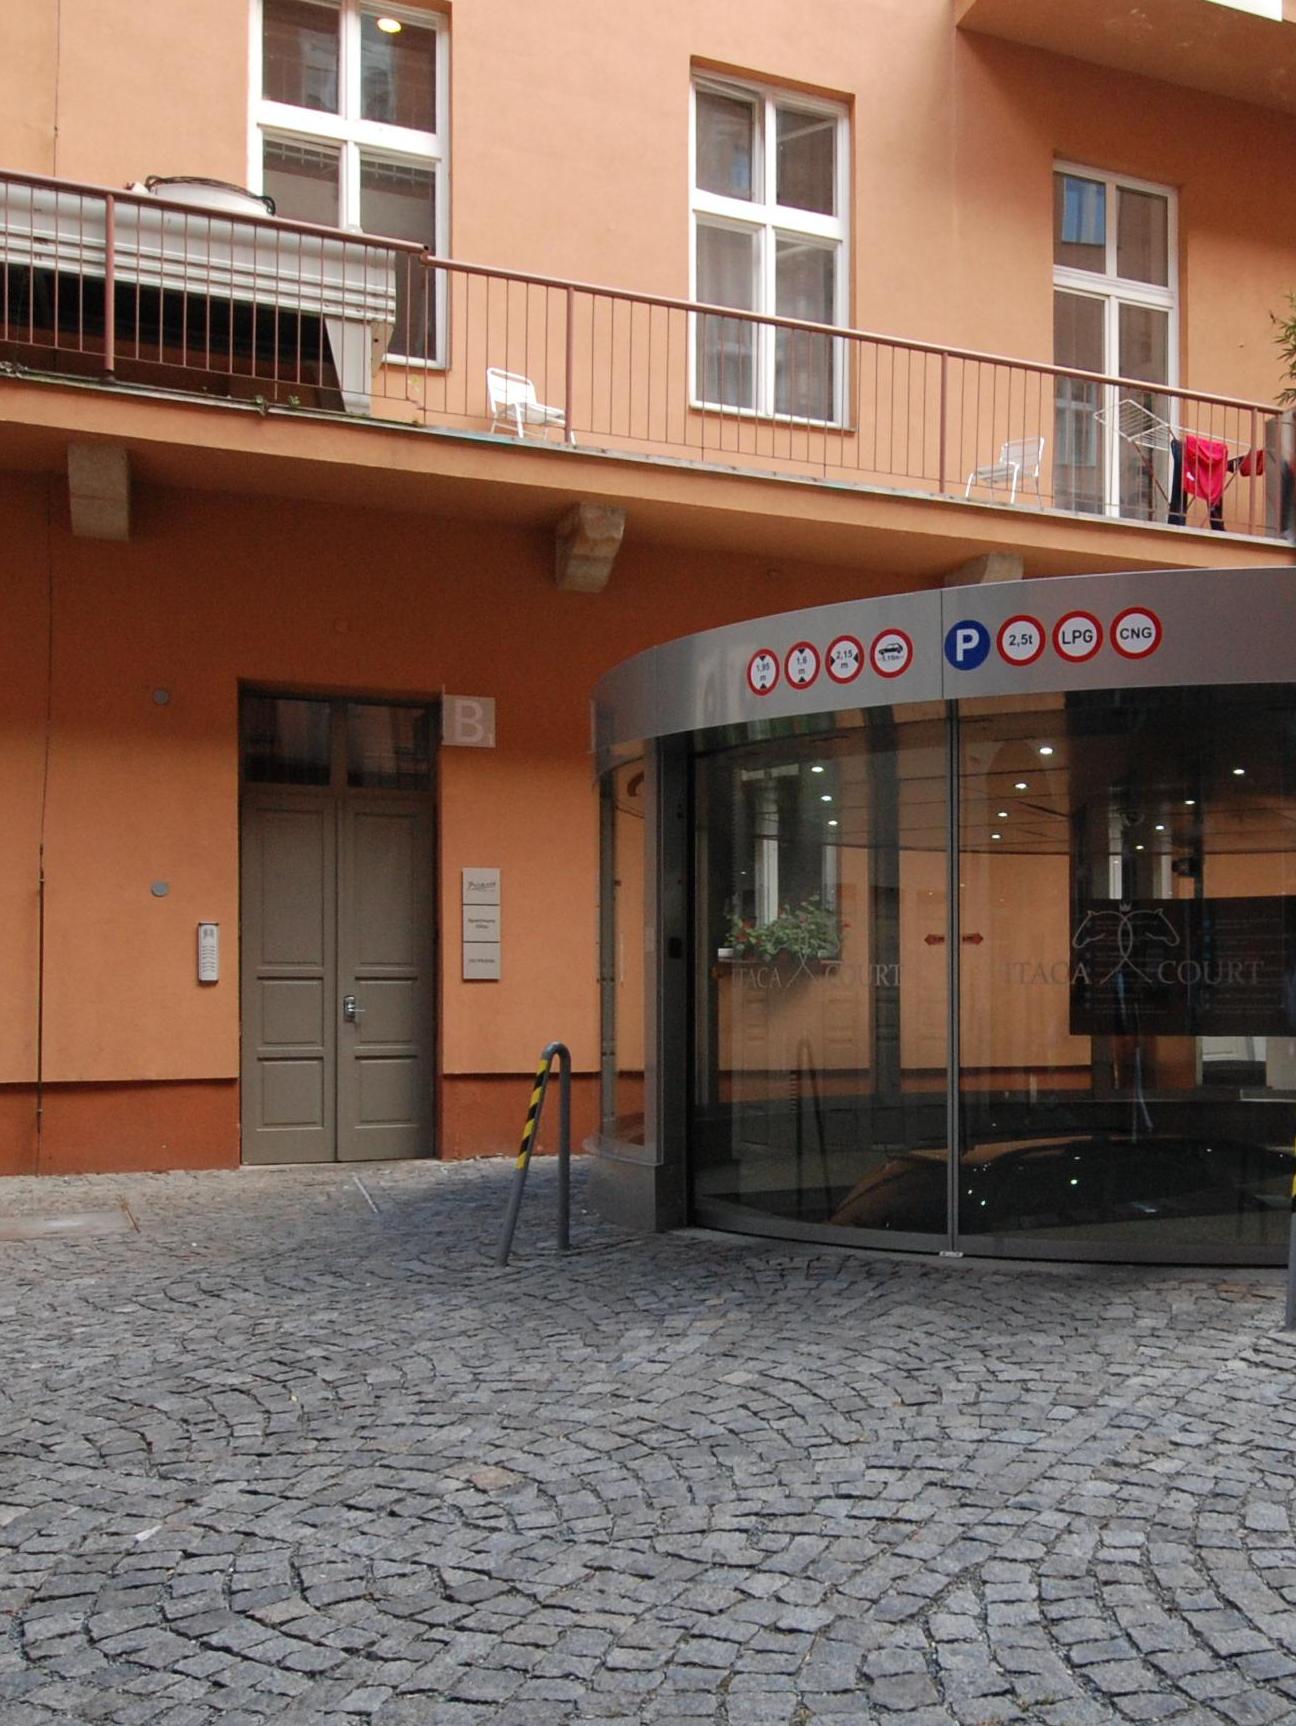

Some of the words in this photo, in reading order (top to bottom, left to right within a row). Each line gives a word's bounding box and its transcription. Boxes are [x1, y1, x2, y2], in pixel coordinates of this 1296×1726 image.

[1008, 633, 1033, 648] 2,5t
[1062, 629, 1093, 645] LPG
[1119, 626, 1153, 640] CNG
[956, 628, 980, 662] P
[835, 649, 853, 660] 2,15
[455, 700, 484, 742] B
[1005, 961, 1092, 985] ITACA
[1157, 959, 1264, 985] COURT
